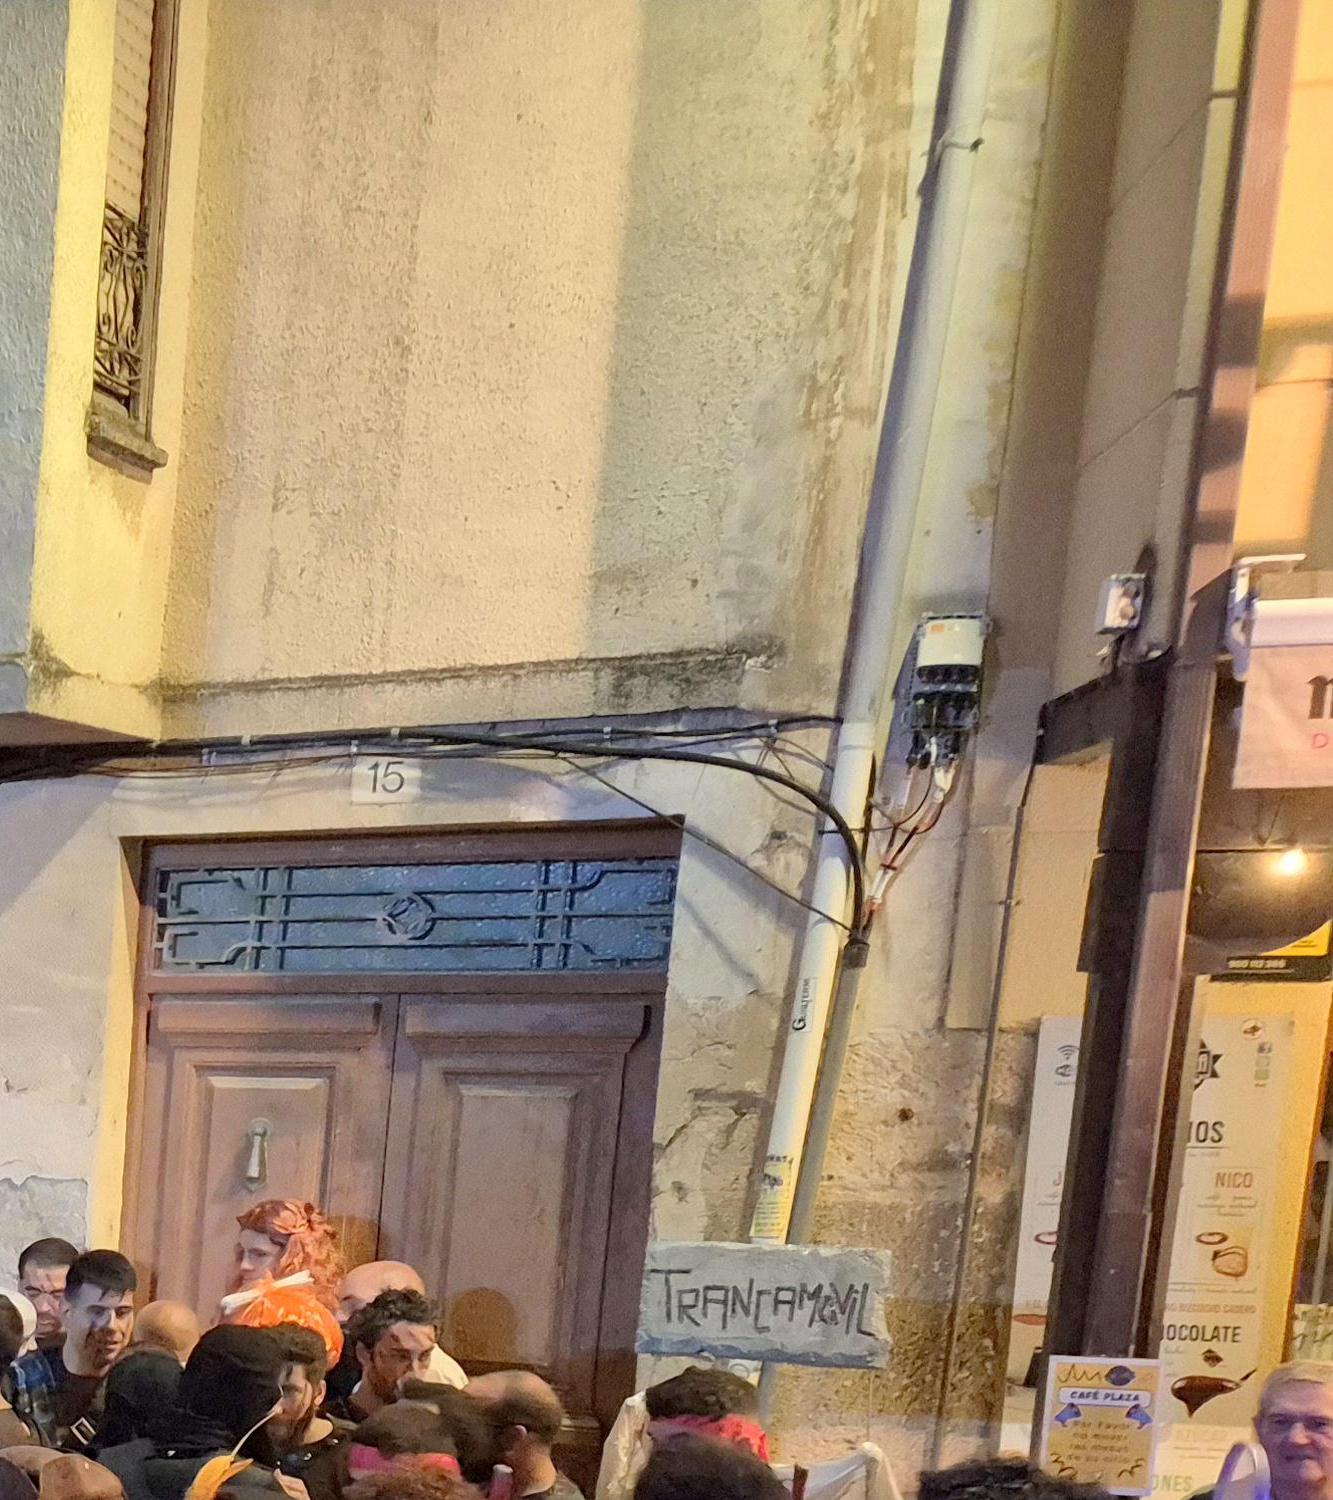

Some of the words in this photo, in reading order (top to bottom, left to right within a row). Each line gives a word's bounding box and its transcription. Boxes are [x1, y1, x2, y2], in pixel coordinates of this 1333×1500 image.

[368, 761, 405, 793] 15
[1215, 1171, 1253, 1189] NICO
[1103, 1391, 1141, 1402] PLAZA
